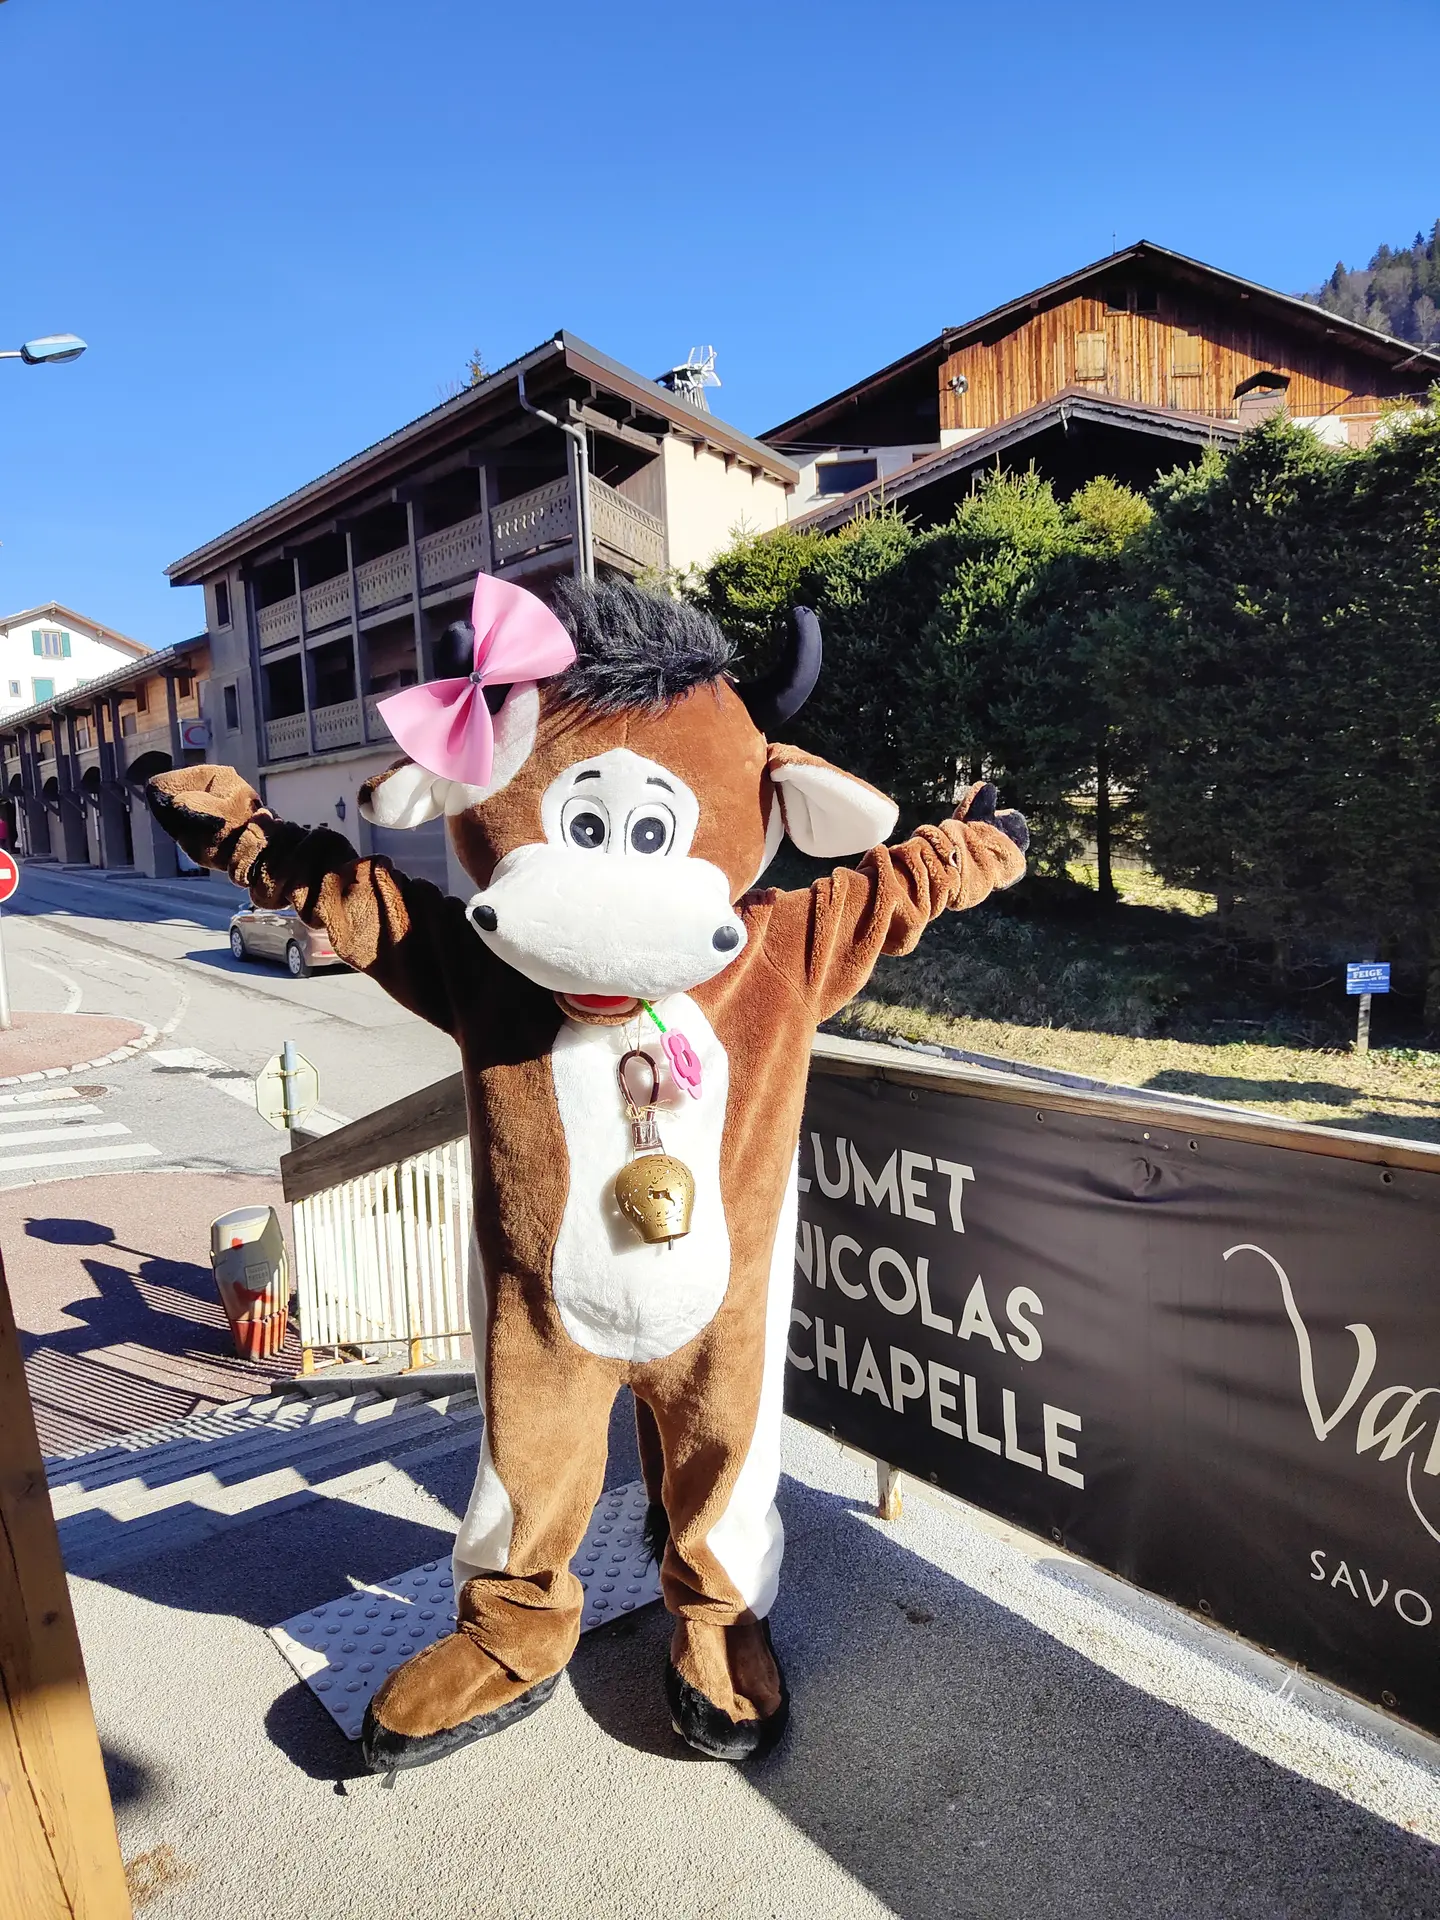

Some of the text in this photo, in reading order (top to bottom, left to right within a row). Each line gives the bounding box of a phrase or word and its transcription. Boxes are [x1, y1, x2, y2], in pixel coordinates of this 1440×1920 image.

[1353, 969, 1383, 978] FEIGE
[798, 1132, 975, 1233] UMET
[787, 1308, 1084, 1490] CHAPELLE
[1310, 1551, 1433, 1626] SAVO
